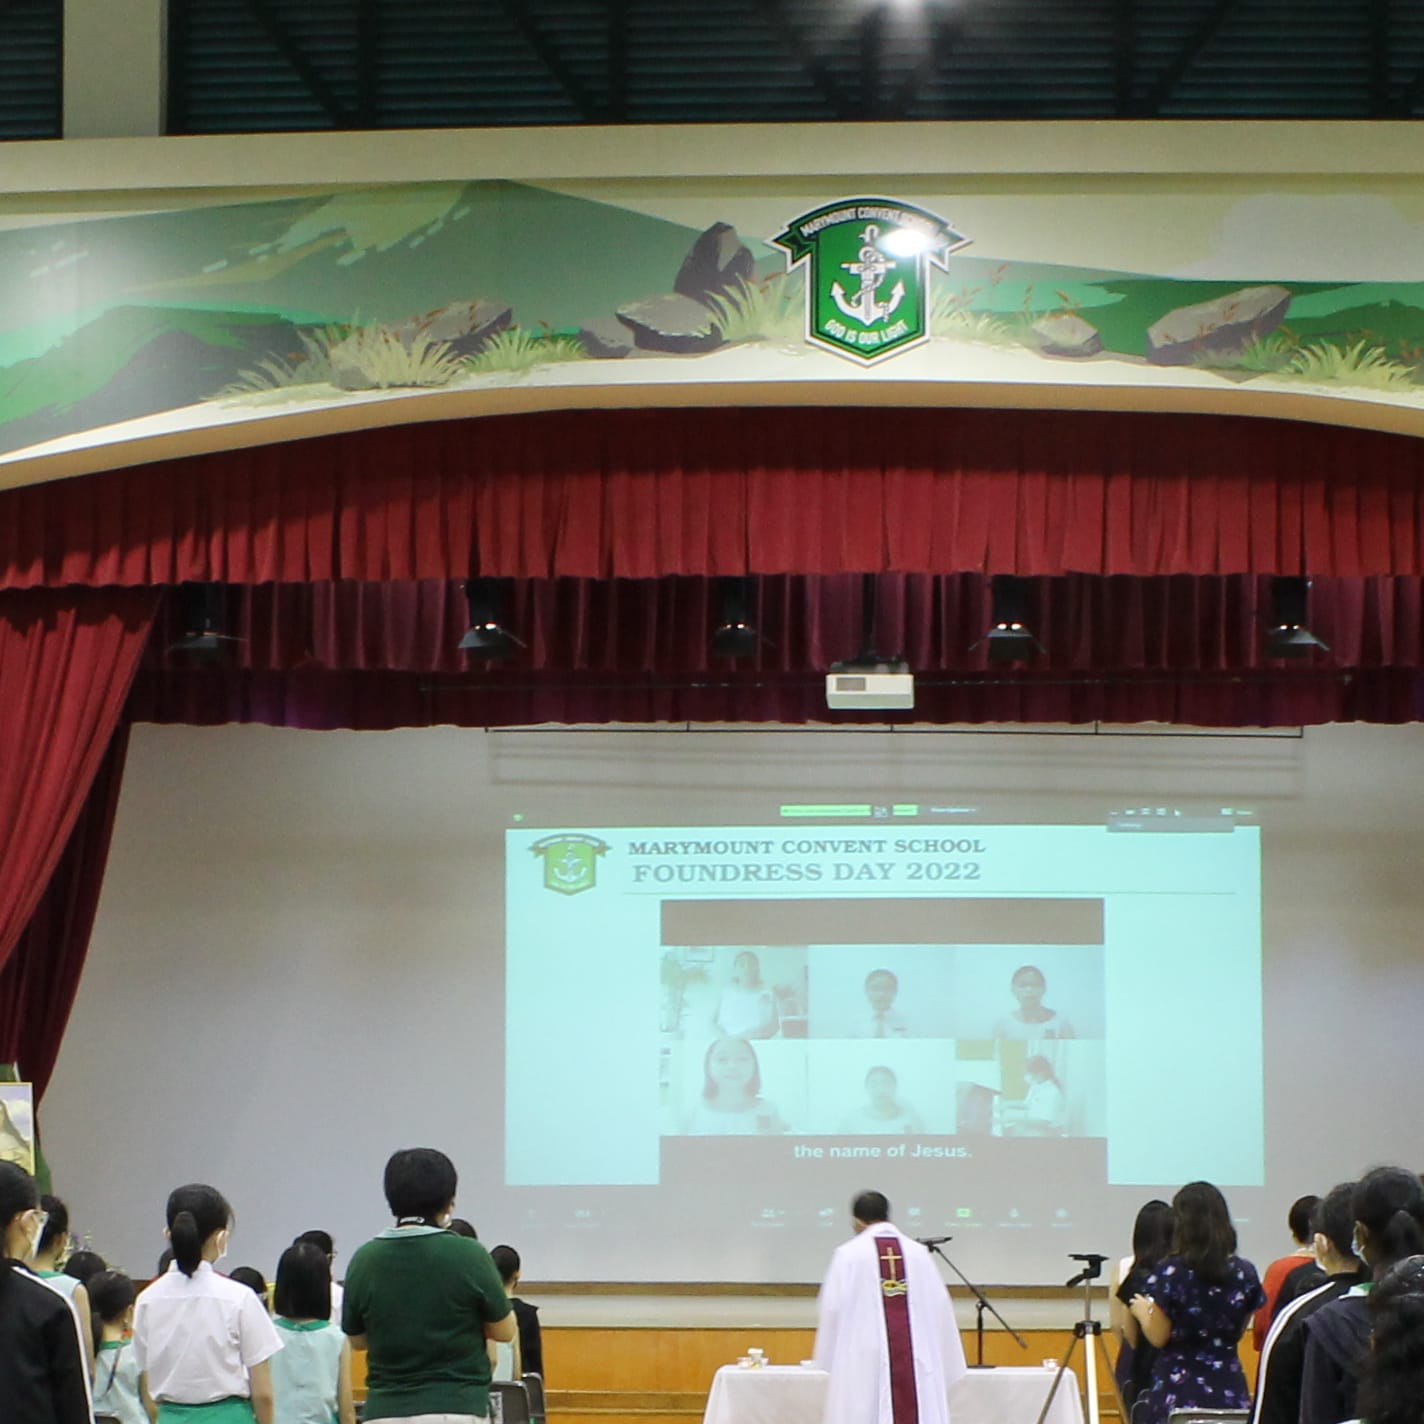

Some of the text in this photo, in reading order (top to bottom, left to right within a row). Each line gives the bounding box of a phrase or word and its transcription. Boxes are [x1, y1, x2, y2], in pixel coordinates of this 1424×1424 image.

[629, 839, 986, 855] MARYMOUNT CONVENT SCHOOL
[632, 862, 980, 882] FOUNDRESS DAY 2022
[794, 1144, 972, 1158] the name of Jesus.
